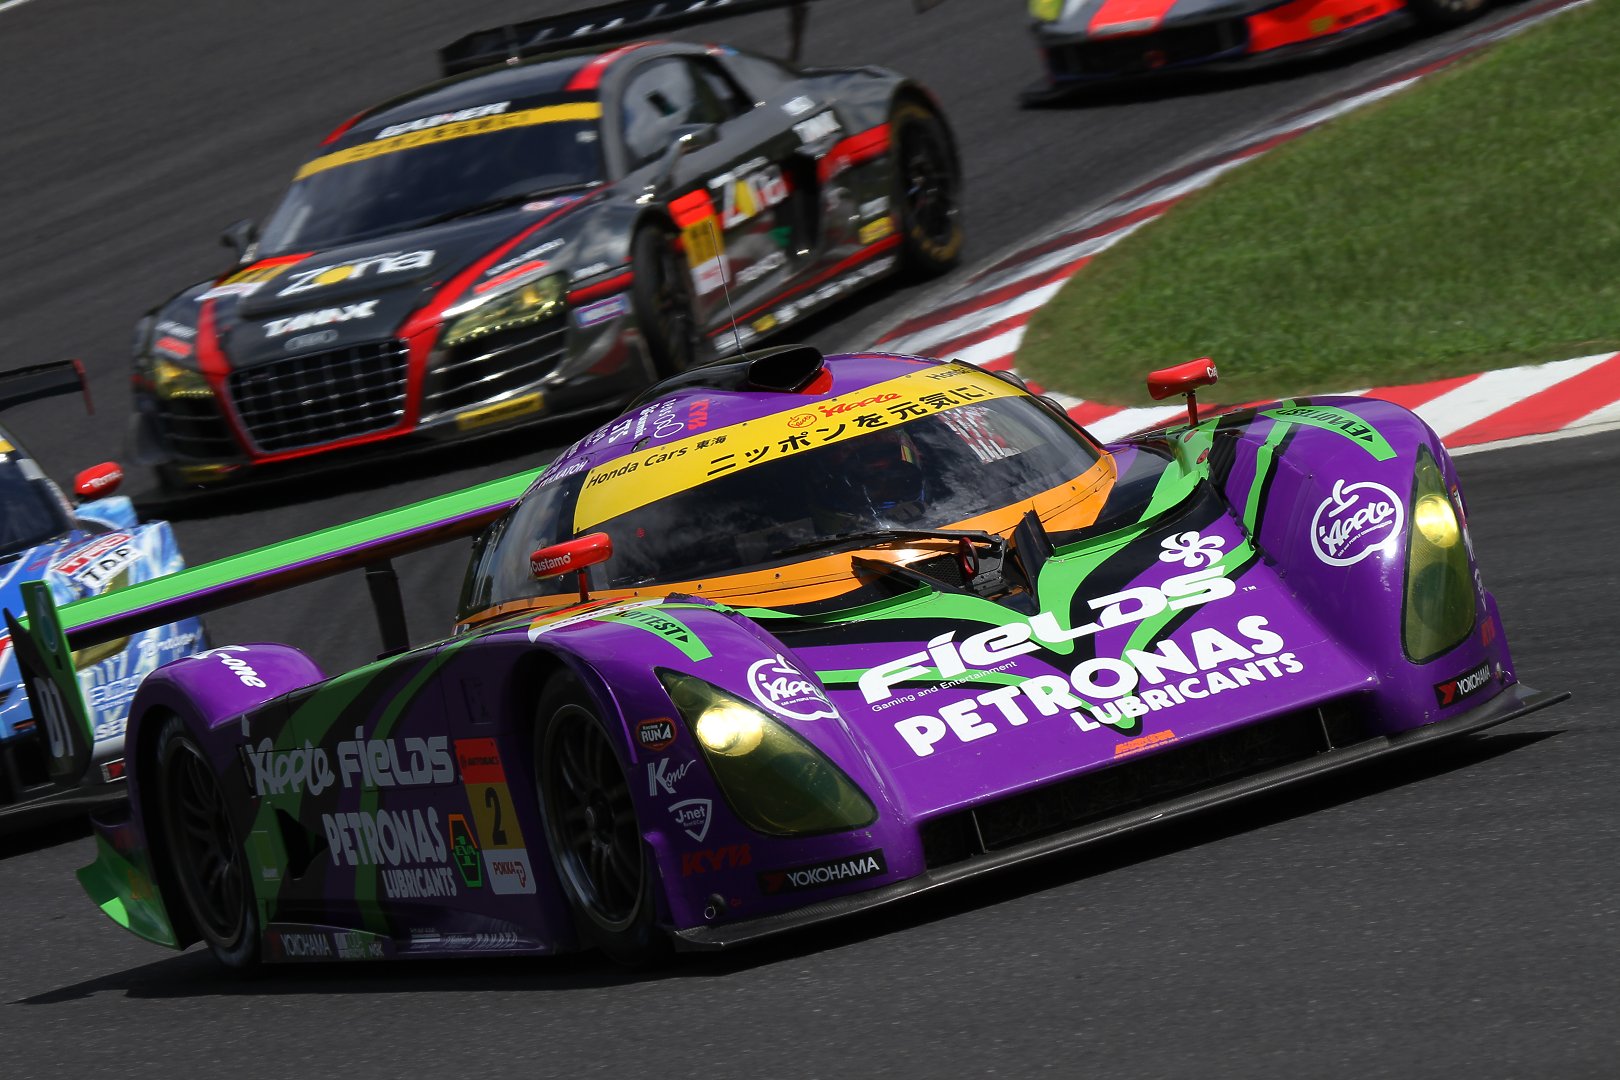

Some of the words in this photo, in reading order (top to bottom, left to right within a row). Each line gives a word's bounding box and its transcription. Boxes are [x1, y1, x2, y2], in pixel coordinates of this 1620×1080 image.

[586, 462, 639, 489] Honda
[644, 446, 688, 467] Cars
[531, 554, 571, 573] Custamo
[871, 693, 916, 712] Gaming
[917, 686, 939, 698] and
[940, 660, 1018, 690] Entertainment
[894, 615, 1284, 757] PETRONAS
[1070, 652, 1304, 732] LUBRICANTS
[1457, 664, 1491, 696] YOKOHAMA
[321, 806, 447, 867] PETRONAS
[485, 787, 508, 845] 2
[381, 866, 457, 899] LUBRICANTS
[787, 857, 880, 888] YOKOHAMA
